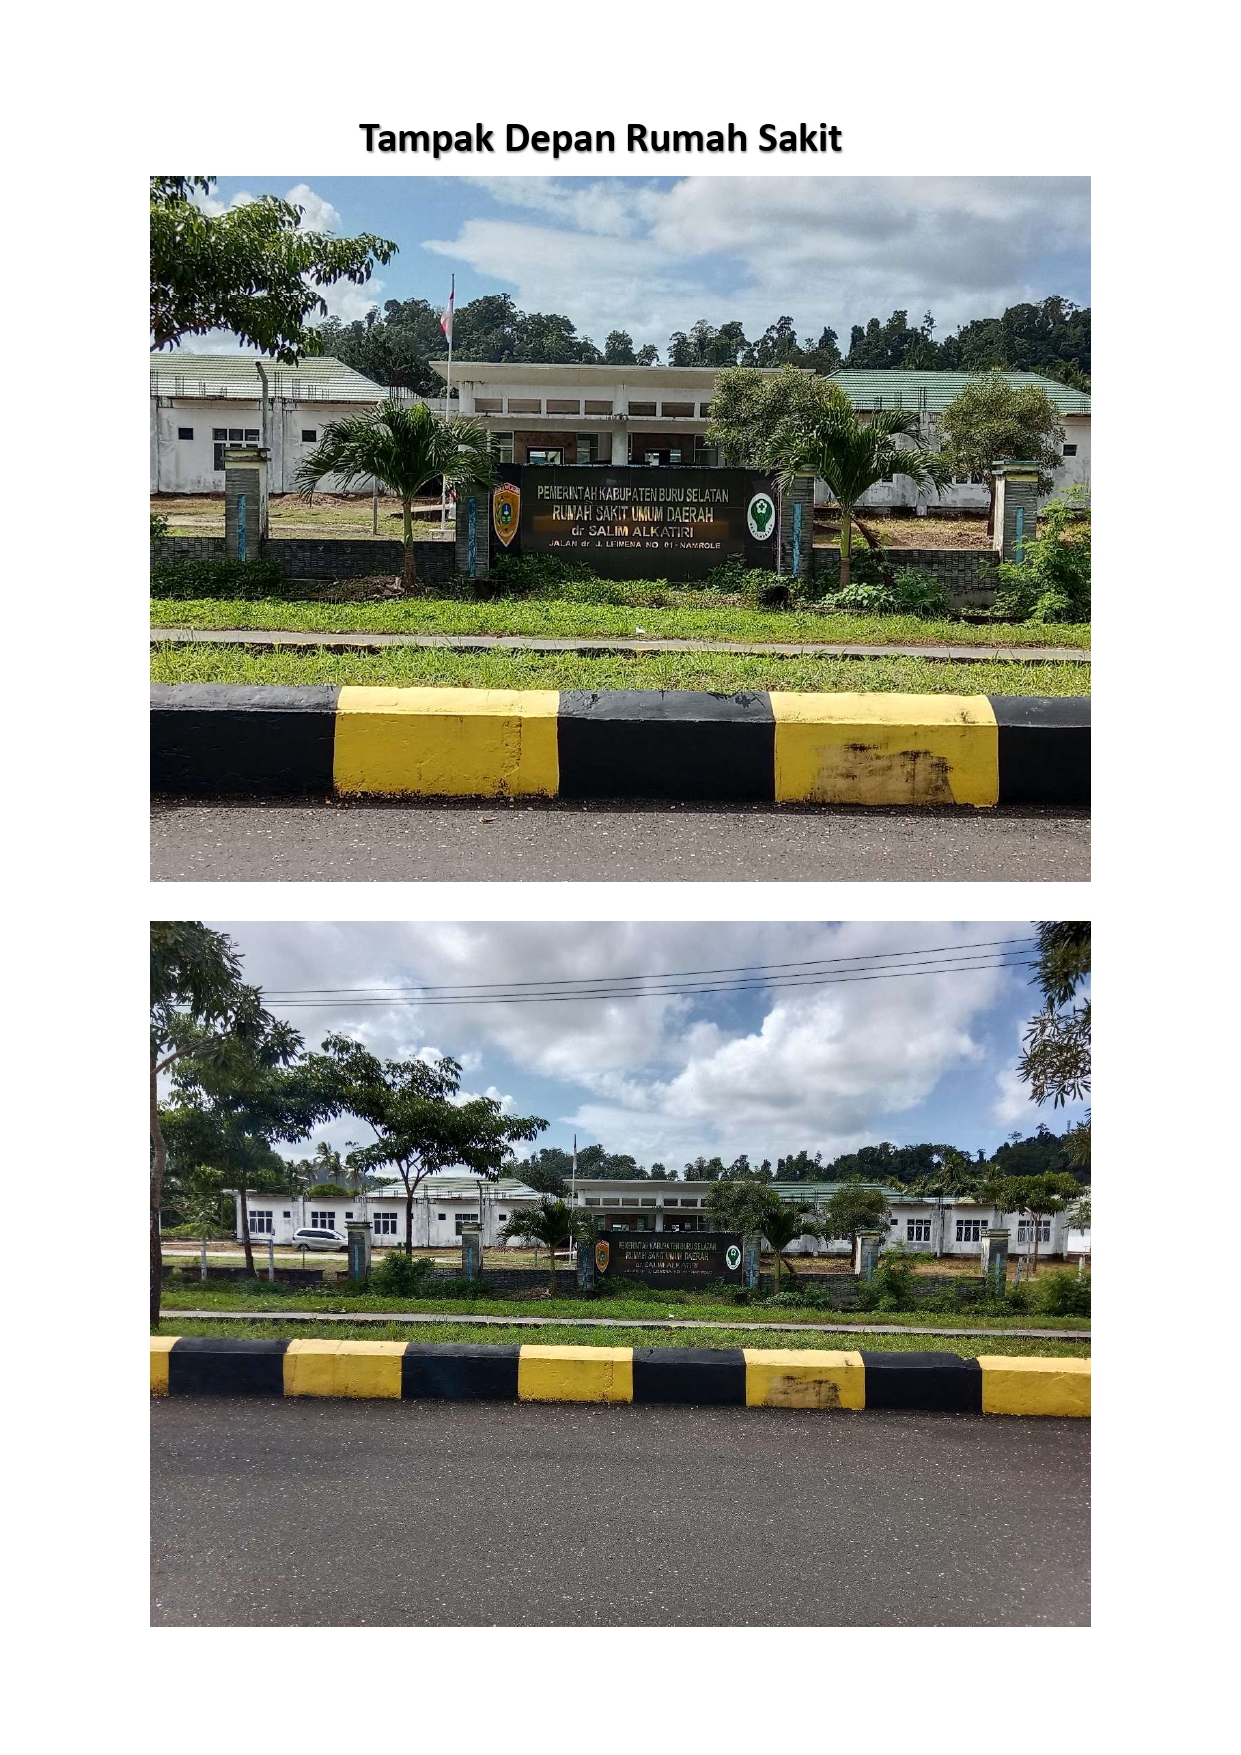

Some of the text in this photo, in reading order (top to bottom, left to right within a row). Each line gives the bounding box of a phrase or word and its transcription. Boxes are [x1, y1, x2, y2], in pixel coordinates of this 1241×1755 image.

[537, 485, 597, 500] PEMERINTAH
[600, 487, 657, 502] KABUPATEN
[659, 488, 684, 502] BURU
[686, 488, 729, 503] SELATAN
[552, 504, 714, 523] RUMAH SAKIT UMUM DAERAH
[571, 525, 694, 538] dr SALIM ALKATIRI
[549, 540, 578, 548] JALAN
[581, 540, 590, 548] dr
[645, 541, 659, 549] NO
